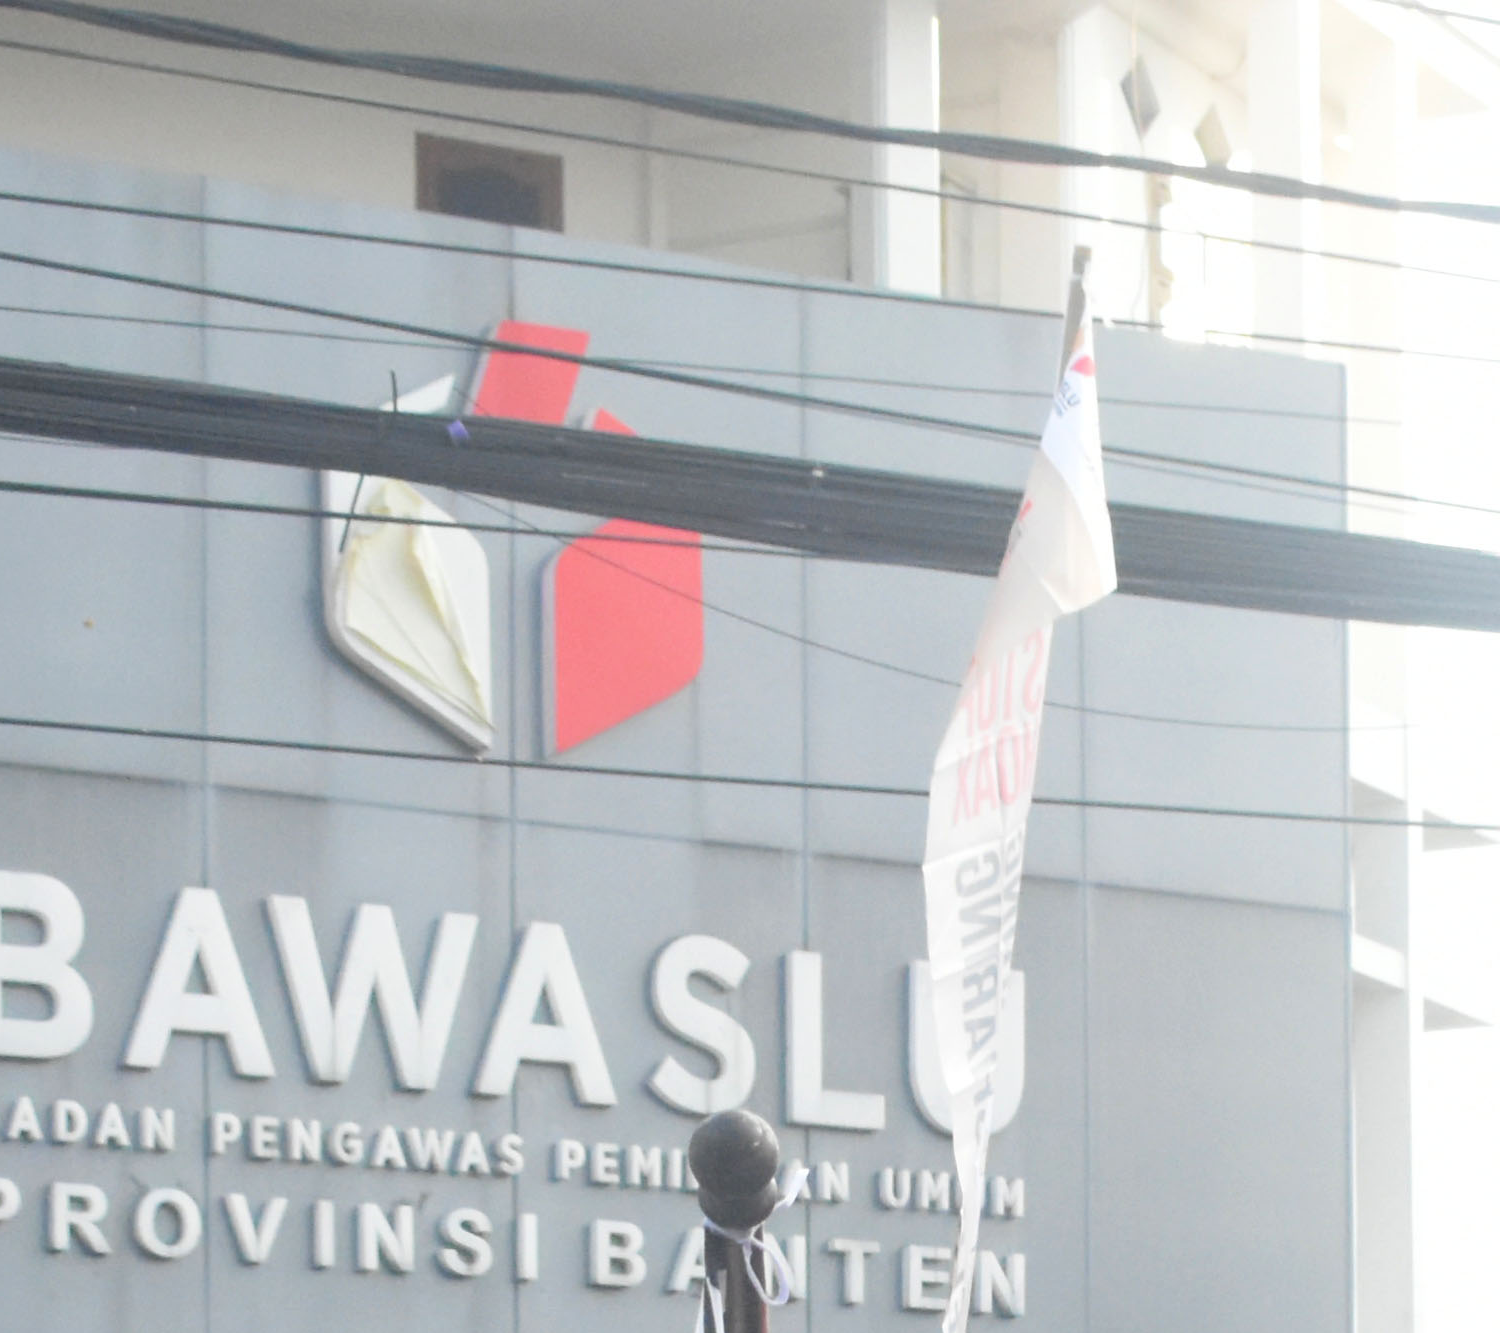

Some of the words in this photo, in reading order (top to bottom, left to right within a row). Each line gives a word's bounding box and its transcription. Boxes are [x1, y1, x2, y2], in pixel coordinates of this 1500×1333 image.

[211, 1112, 525, 1176] PENGAWAS
[557, 1138, 849, 1202] PEMIAN
[879, 1166, 1026, 1219] UMM
